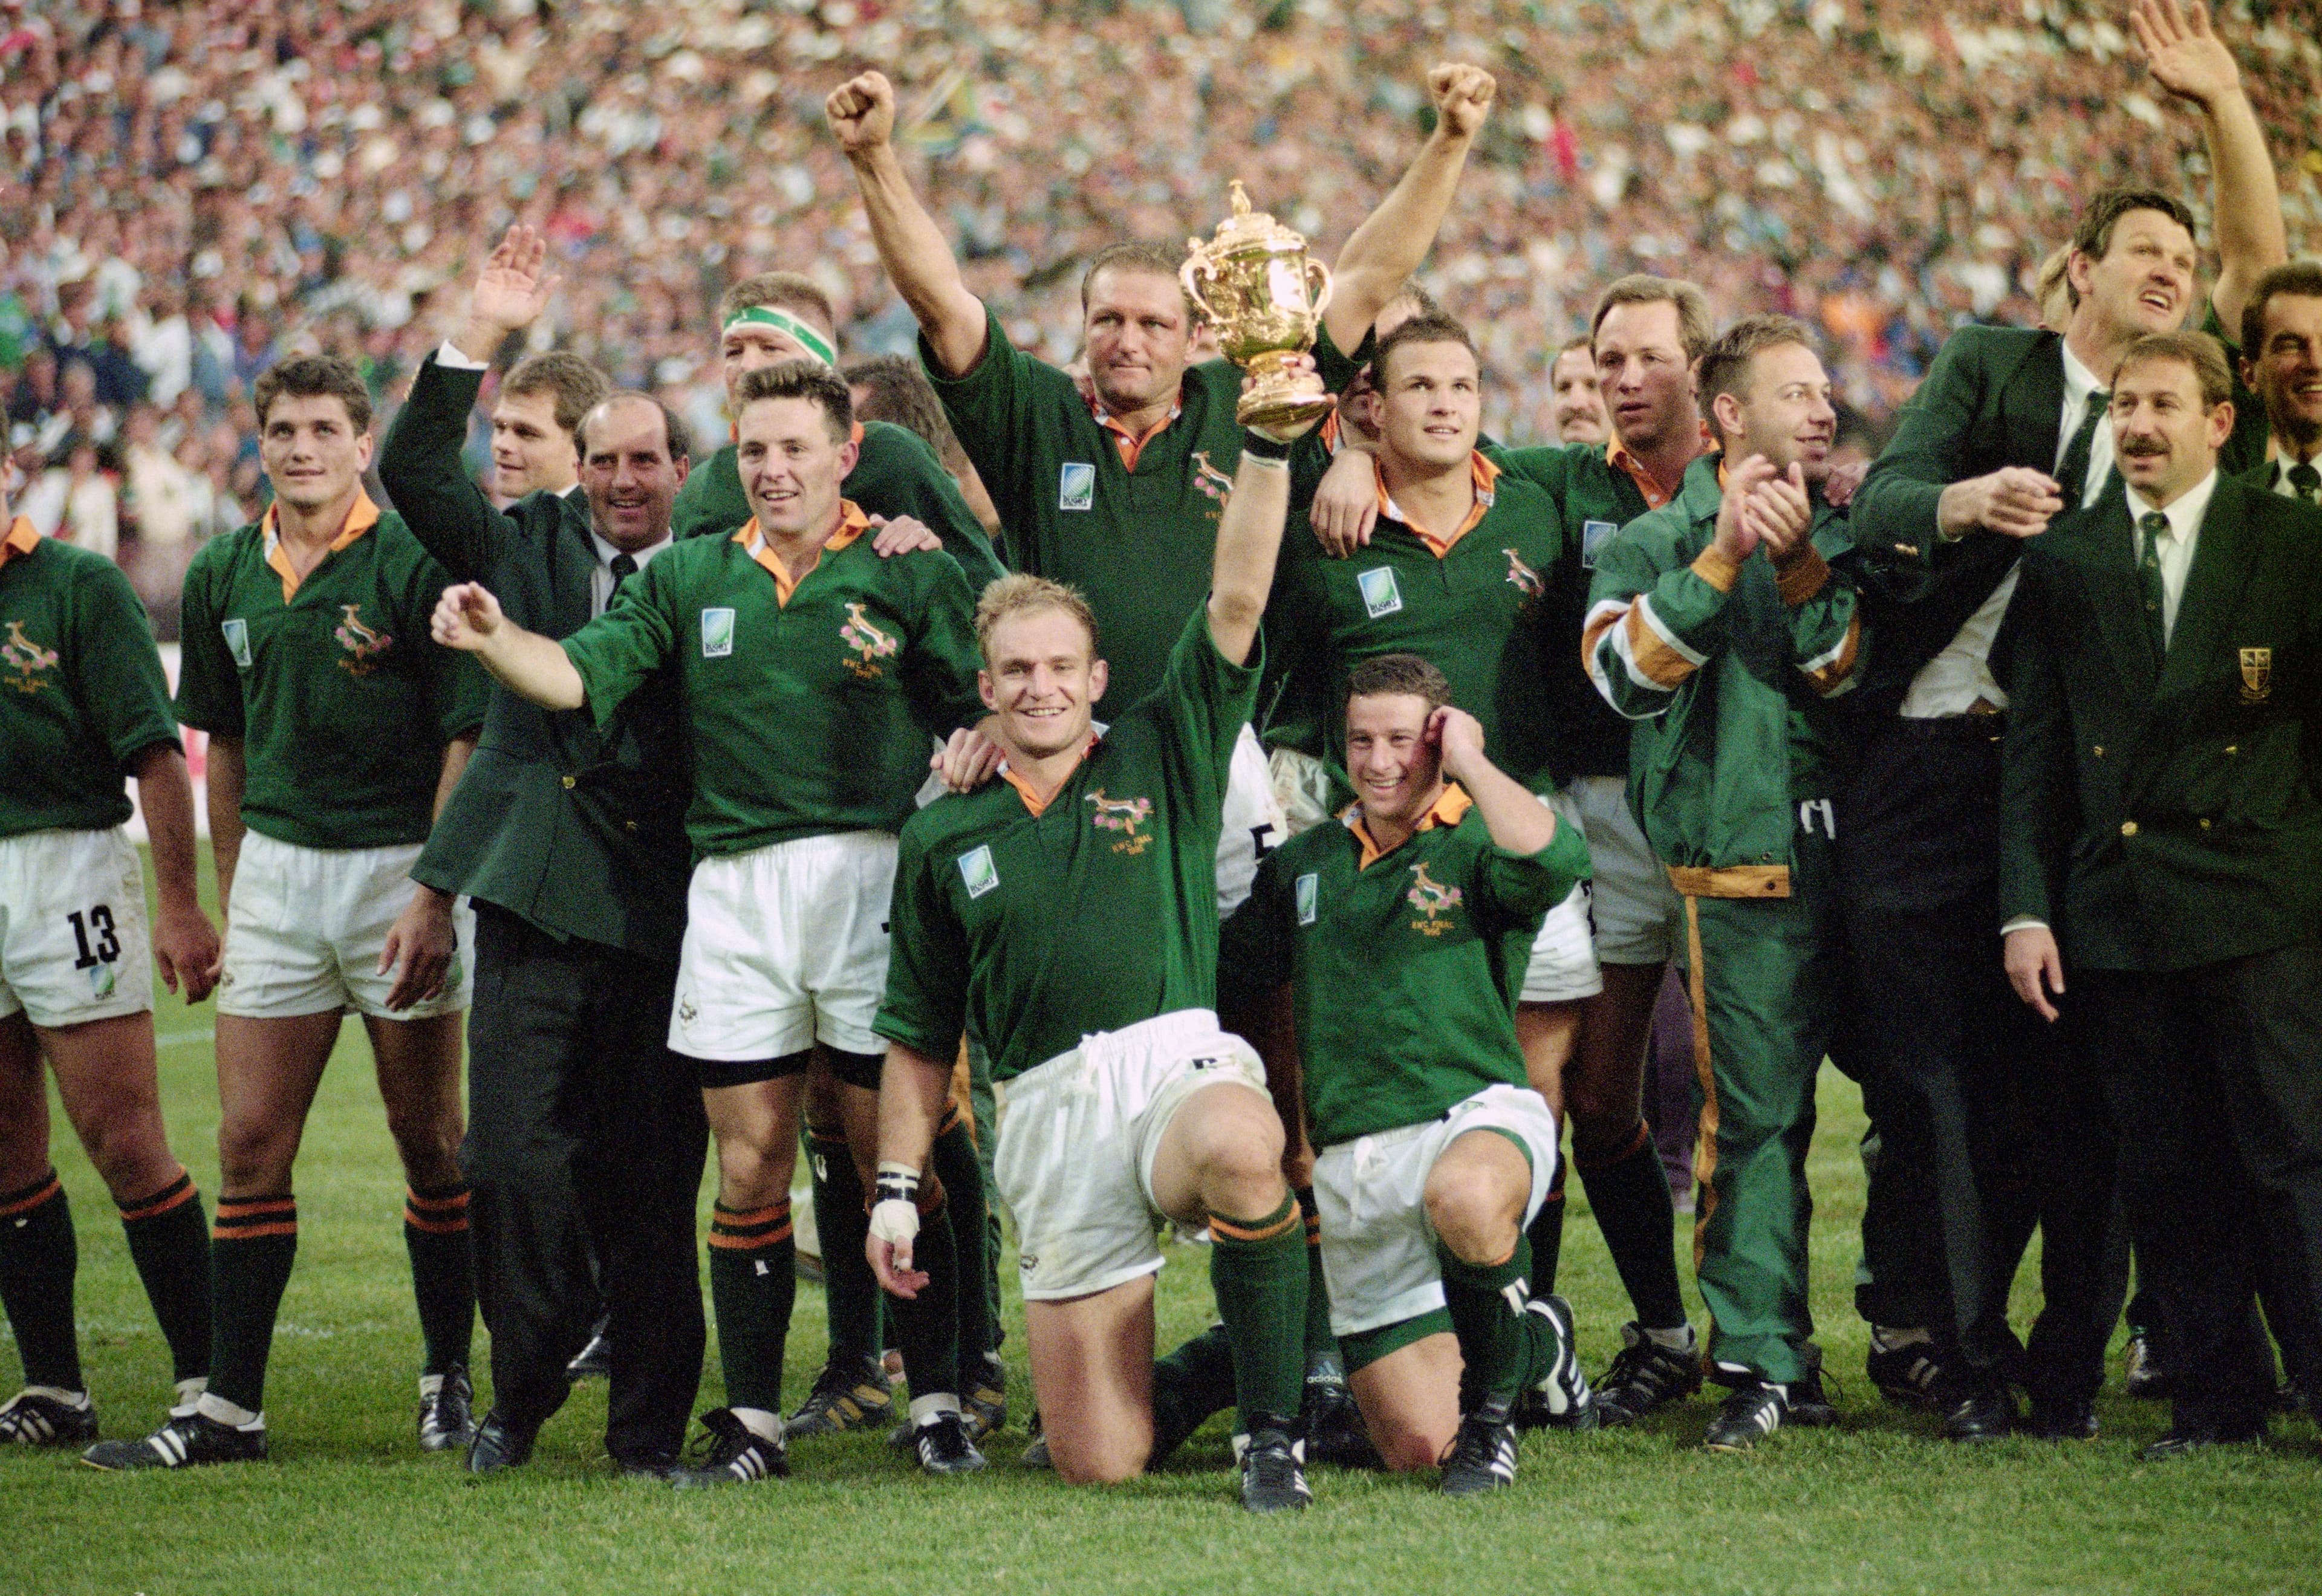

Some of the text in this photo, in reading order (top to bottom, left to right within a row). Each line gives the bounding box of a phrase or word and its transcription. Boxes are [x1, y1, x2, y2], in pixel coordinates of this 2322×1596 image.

[1370, 598, 1396, 611] RUGBY
[67, 904, 121, 970] 13
[1307, 1374, 1343, 1384] adidas
